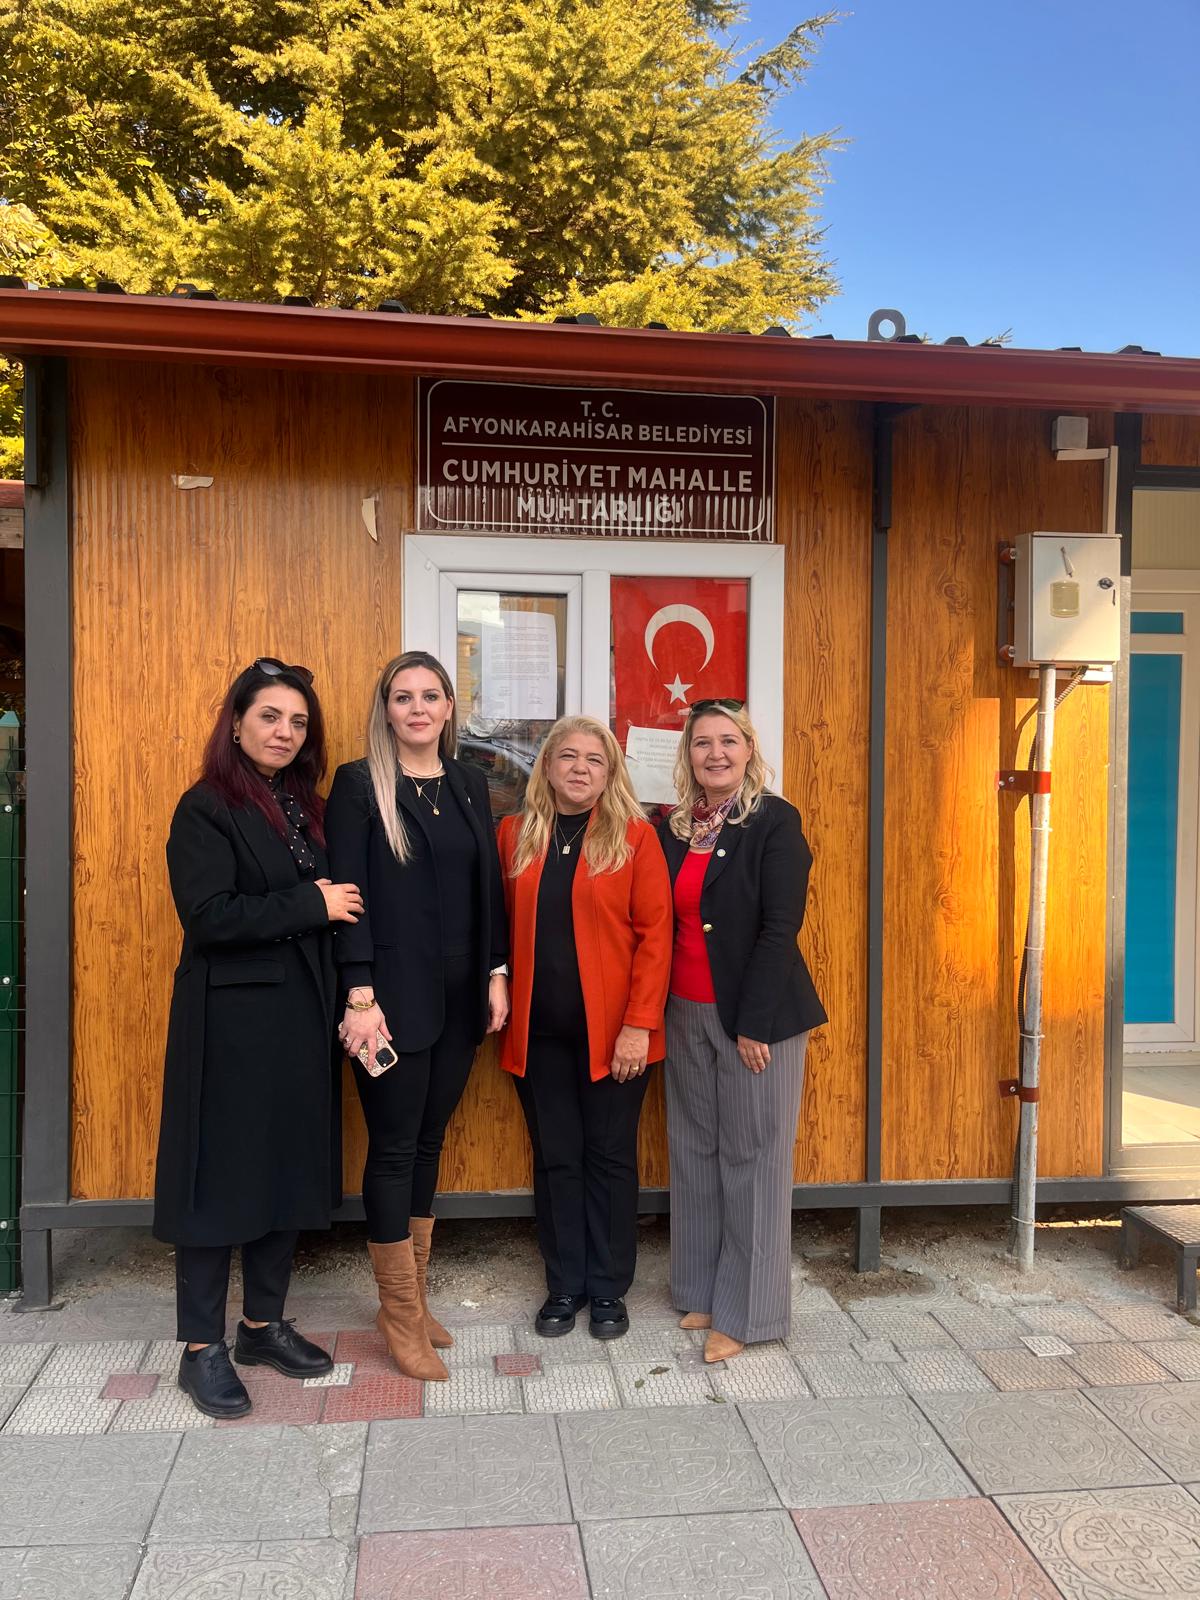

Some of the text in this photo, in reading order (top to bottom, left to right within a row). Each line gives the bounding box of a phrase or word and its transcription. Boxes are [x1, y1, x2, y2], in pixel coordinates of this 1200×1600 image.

[580, 401, 620, 418] T. C.
[443, 416, 752, 446] AFYONKARAHİSAR BELEDİYESİ
[442, 459, 753, 492] CUMHURİYET MAHALLE
[517, 494, 681, 523] MUHTARLIĞI
